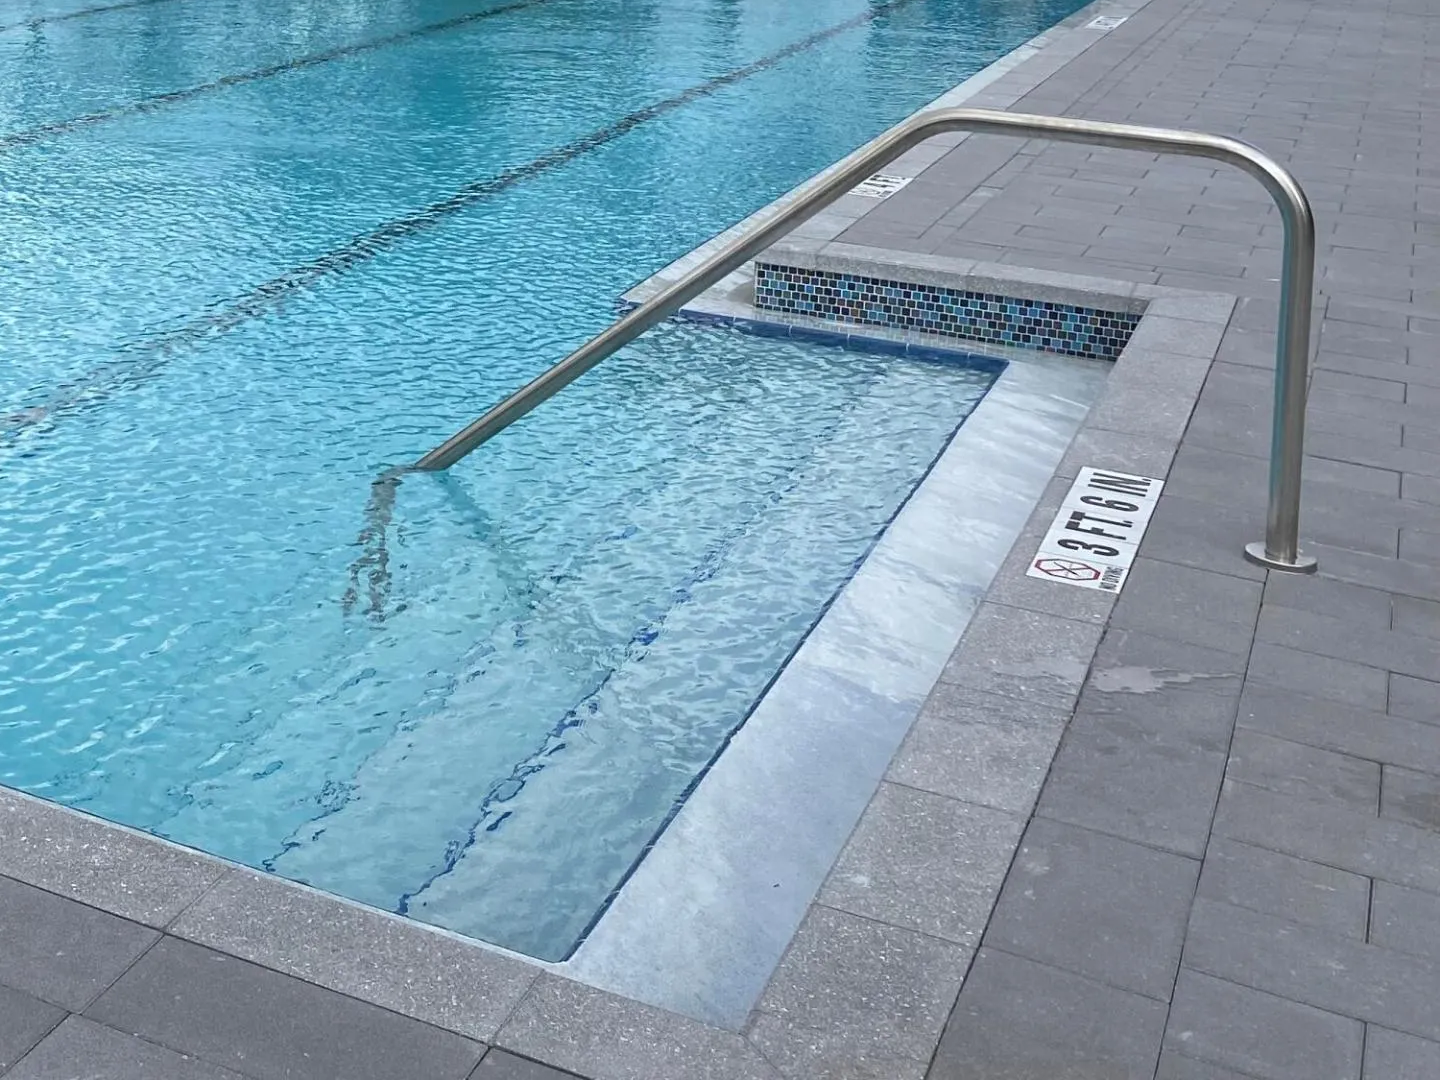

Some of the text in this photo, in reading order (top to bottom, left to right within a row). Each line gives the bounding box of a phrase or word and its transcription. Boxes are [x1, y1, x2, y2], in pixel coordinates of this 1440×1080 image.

[1057, 472, 1152, 557] 3 FT. 6 IN.
